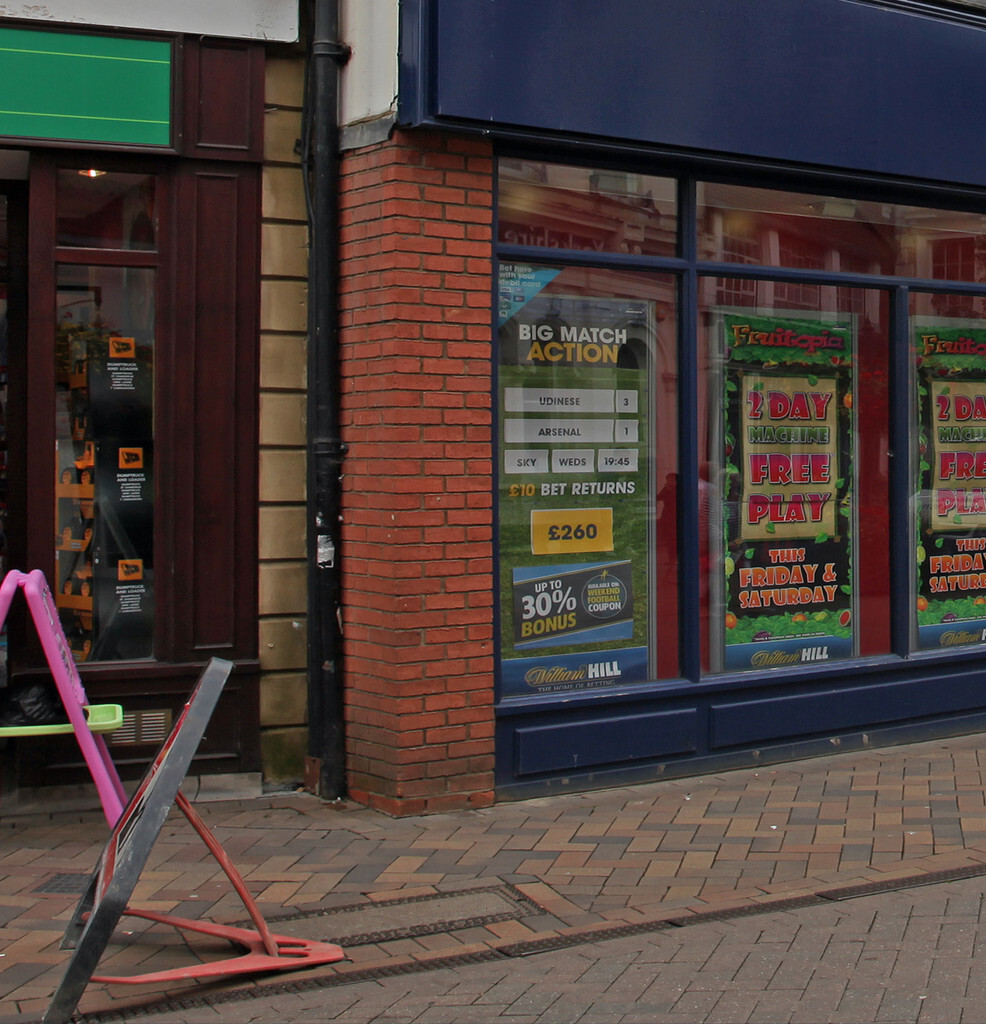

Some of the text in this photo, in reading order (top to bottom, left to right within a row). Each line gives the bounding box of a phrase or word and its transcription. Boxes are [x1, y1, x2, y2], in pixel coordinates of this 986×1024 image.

[514, 265, 533, 273] here
[519, 324, 628, 344] BIG MATCH
[732, 324, 845, 354] Fruitopia
[526, 341, 620, 364] ACTION
[539, 396, 581, 406] UDINESE
[623, 397, 629, 407] 3
[747, 390, 832, 420] 2 DAY
[936, 394, 950, 421] 2
[538, 427, 582, 437] ARSENAL
[624, 427, 629, 436] 1
[748, 426, 830, 444] MACHINE
[516, 458, 537, 467] SKY
[559, 457, 587, 466] WEDS
[604, 457, 630, 466] 19:45
[749, 453, 831, 485] FREE
[508, 481, 636, 497] £10 BET RETURNS
[748, 492, 831, 524] PLAY
[548, 523, 598, 541] £260
[955, 538, 986, 552] THIS
[769, 548, 806, 564] THIS
[738, 562, 838, 588] FRIDAY &
[534, 579, 563, 593] UP TO
[587, 587, 621, 596] WEEKEND
[521, 586, 577, 621] 30%
[587, 595, 620, 604] FOOTBALL
[738, 584, 839, 609] SATURDAY
[588, 602, 622, 612] COUPON
[521, 612, 577, 638] BONUS
[750, 645, 829, 669] William HILL
[524, 660, 622, 687] William HILL
